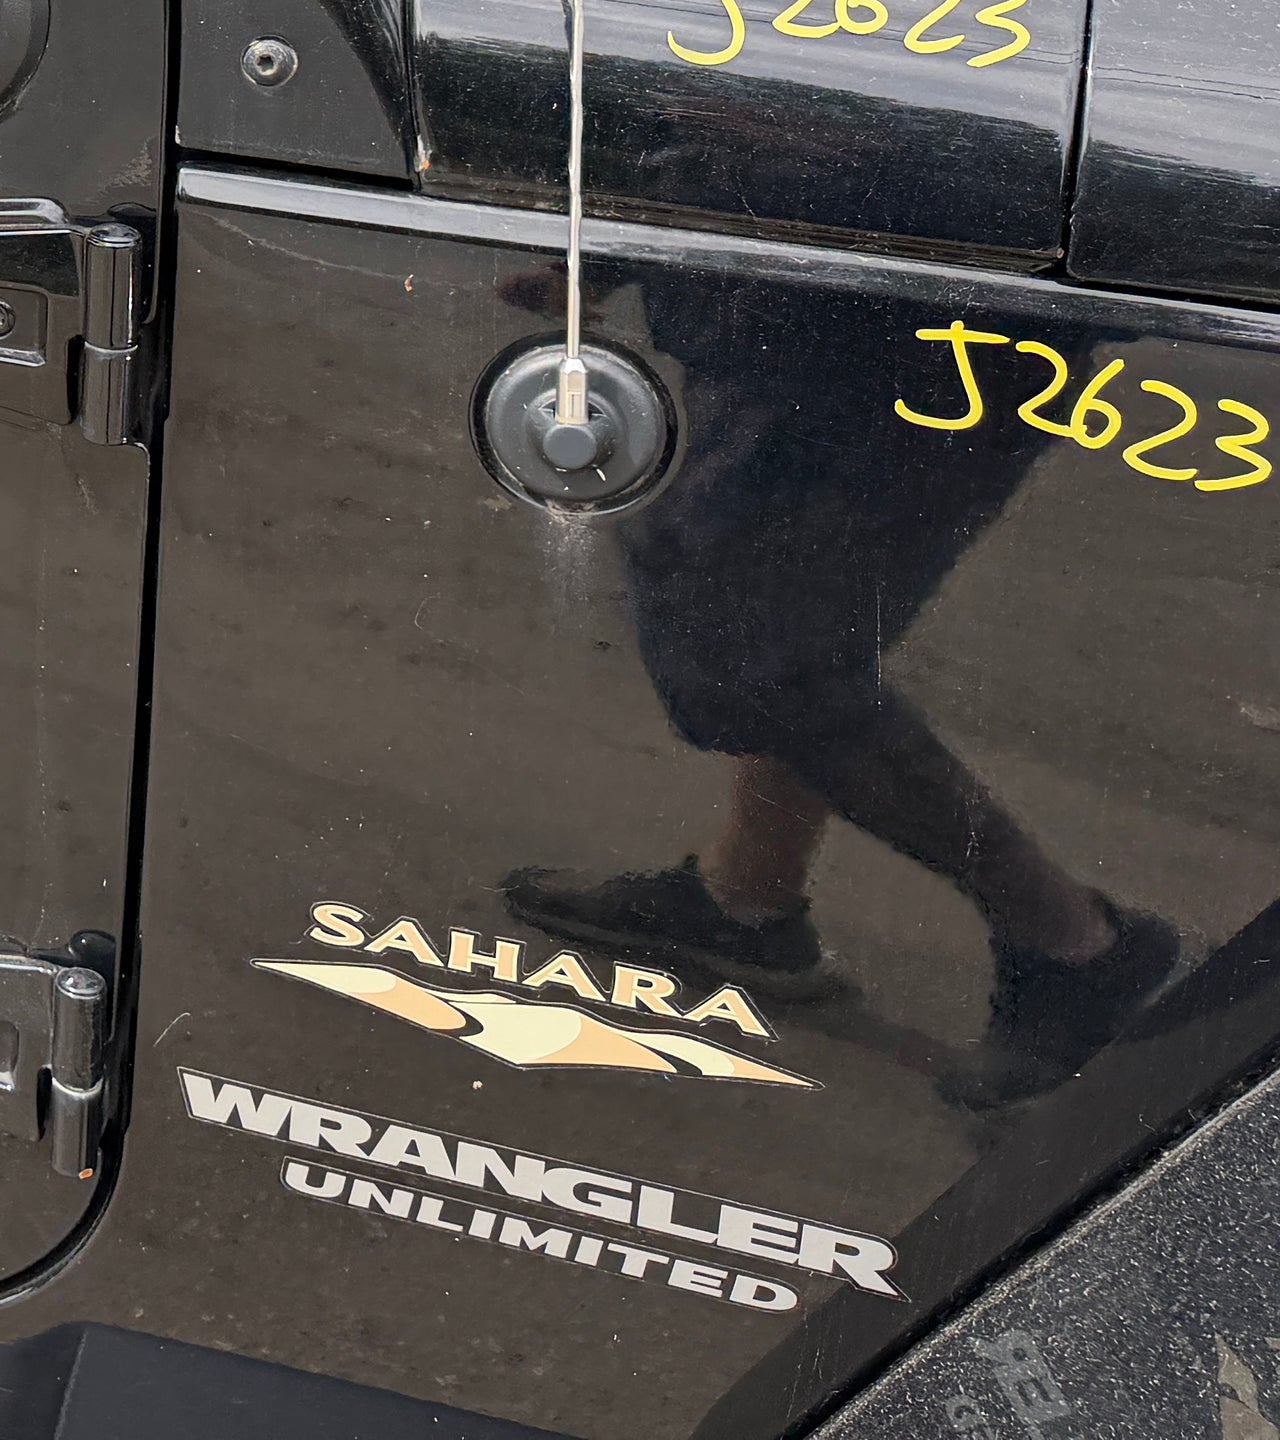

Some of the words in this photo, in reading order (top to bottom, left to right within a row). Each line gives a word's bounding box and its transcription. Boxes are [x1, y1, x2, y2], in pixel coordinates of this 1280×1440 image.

[894, 320, 1274, 492] J2623
[310, 903, 771, 1037] SAHARA
[179, 1072, 900, 1297] WRANGLER
[284, 1161, 800, 1312] UNLIMITED
